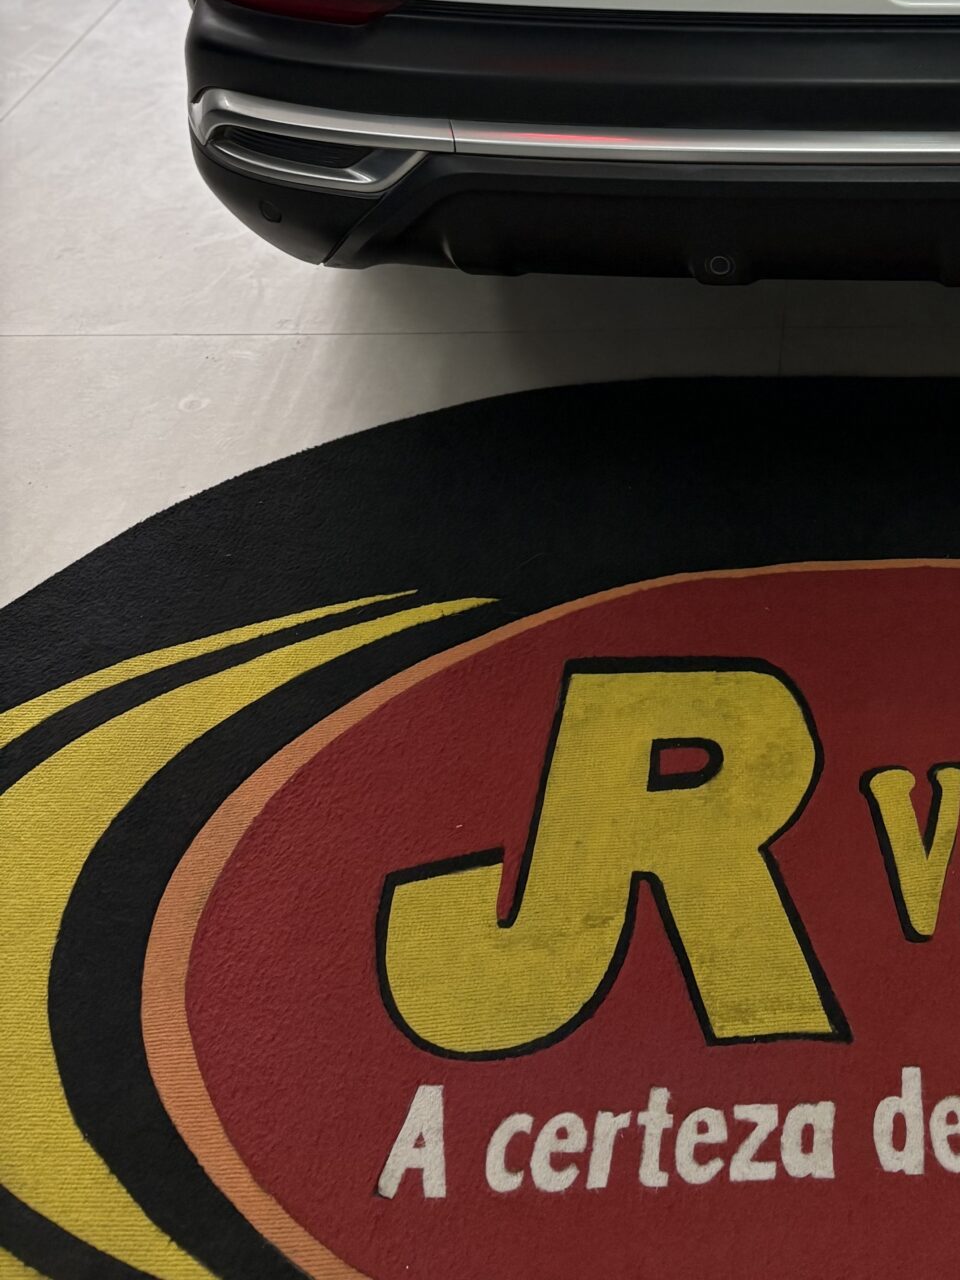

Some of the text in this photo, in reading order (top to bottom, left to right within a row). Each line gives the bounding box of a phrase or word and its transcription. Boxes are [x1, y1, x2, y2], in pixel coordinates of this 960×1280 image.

[376, 656, 853, 1062] JR
[376, 1084, 447, 1199] A
[485, 1086, 836, 1194] certeza
